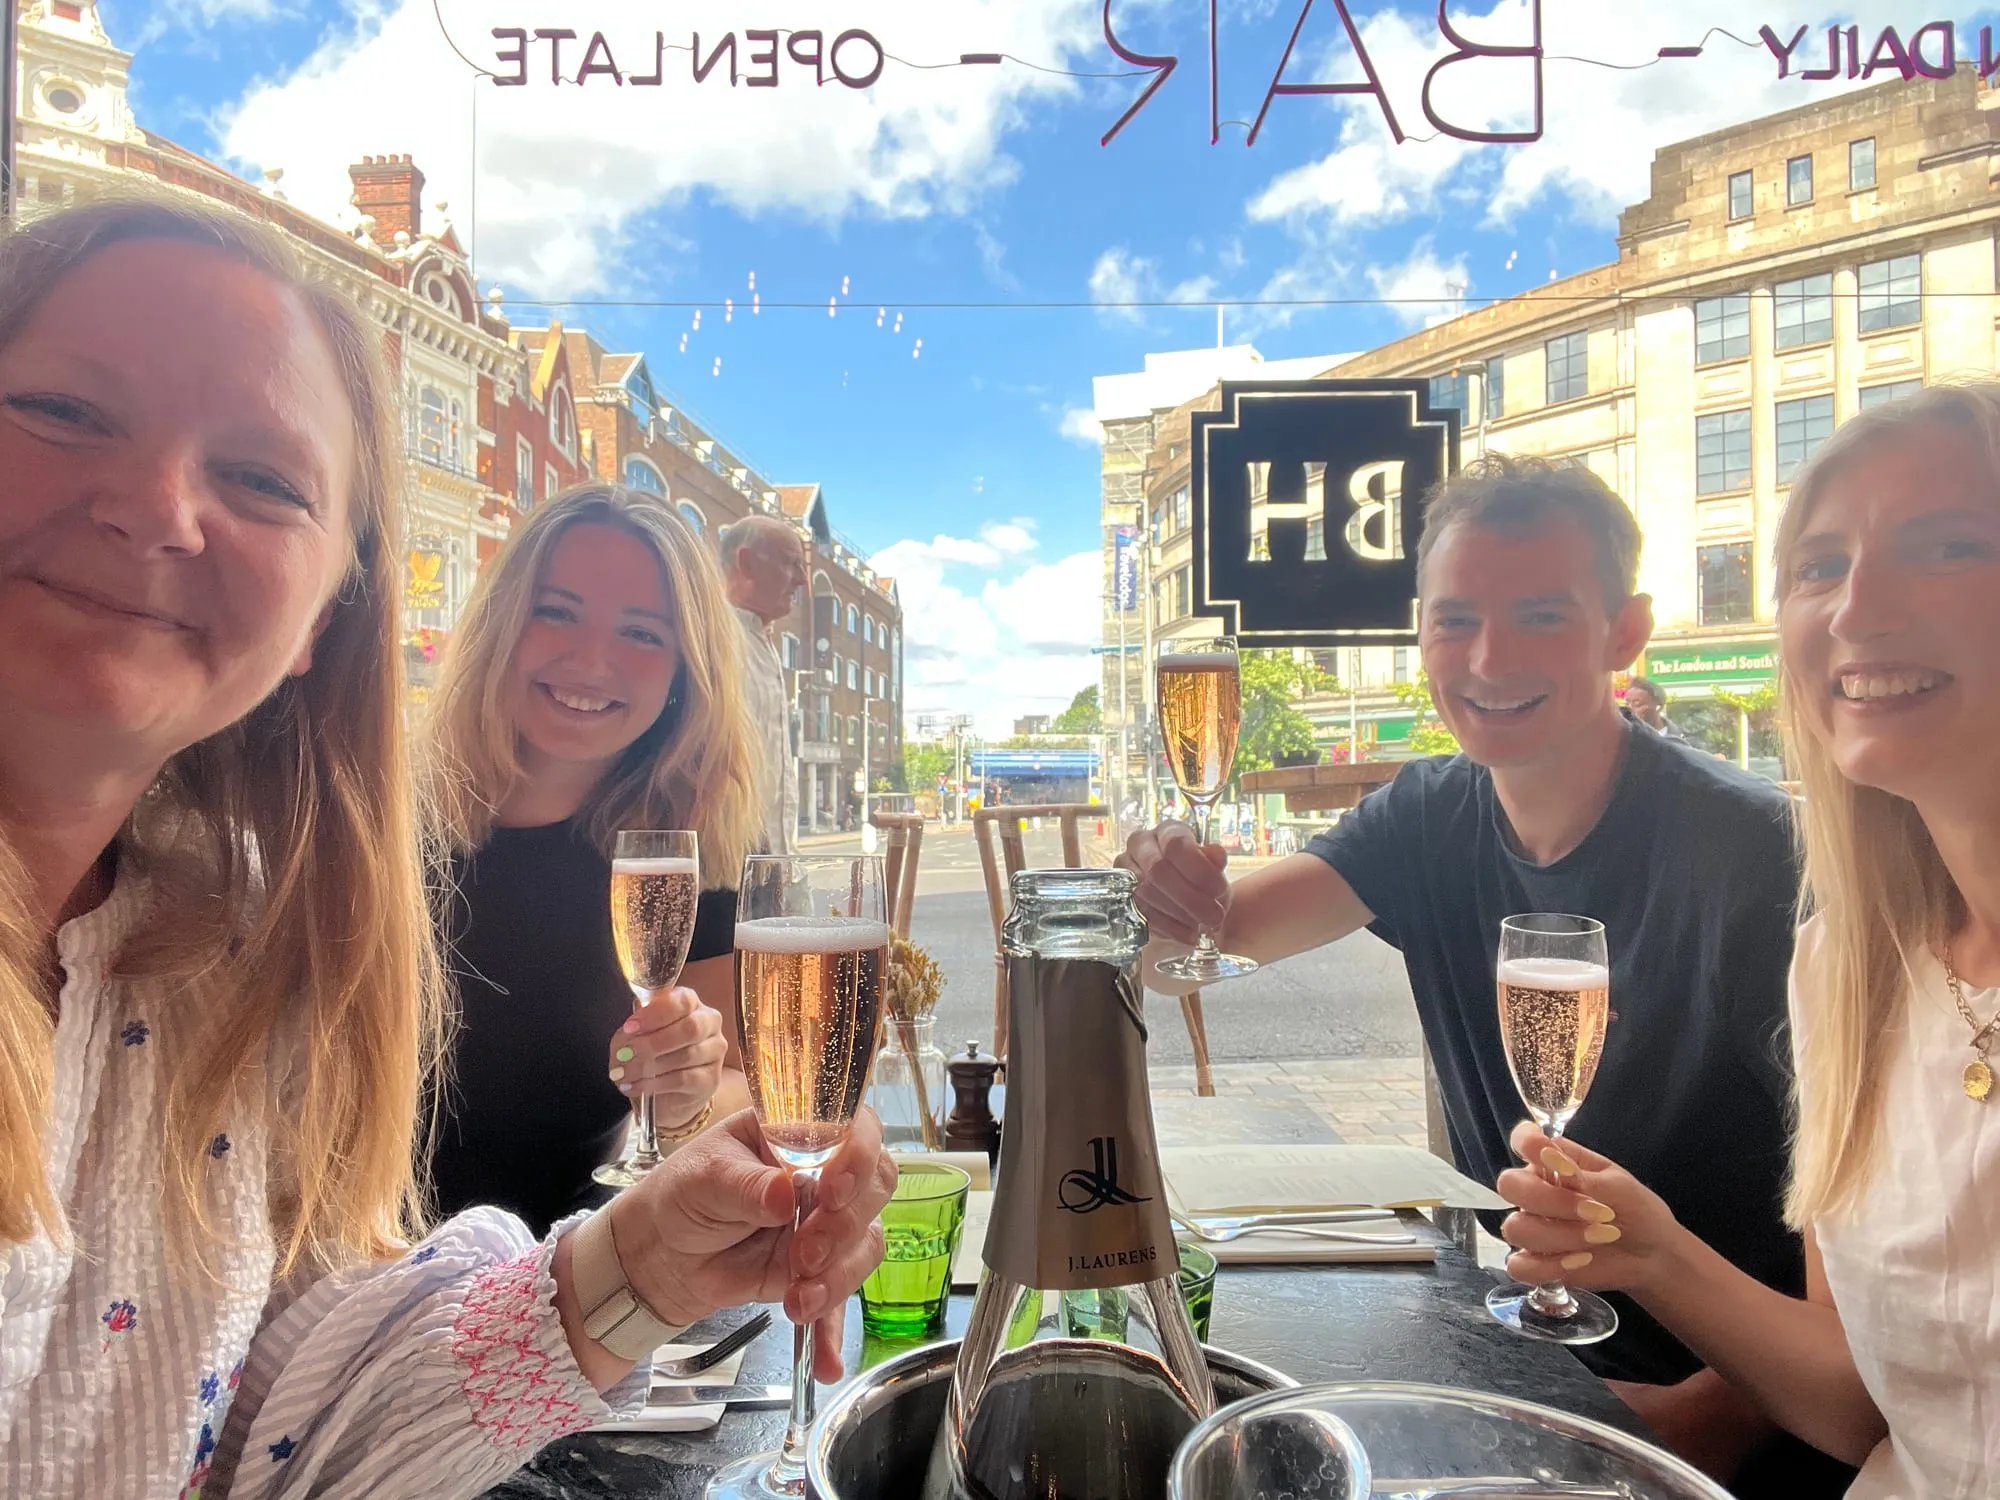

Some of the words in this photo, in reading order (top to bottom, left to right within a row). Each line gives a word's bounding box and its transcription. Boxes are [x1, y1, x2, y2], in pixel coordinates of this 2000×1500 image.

[1652, 660, 1672, 674] The
[1673, 657, 1713, 673] London
[1714, 656, 1737, 671] and
[1739, 654, 1773, 670] South
